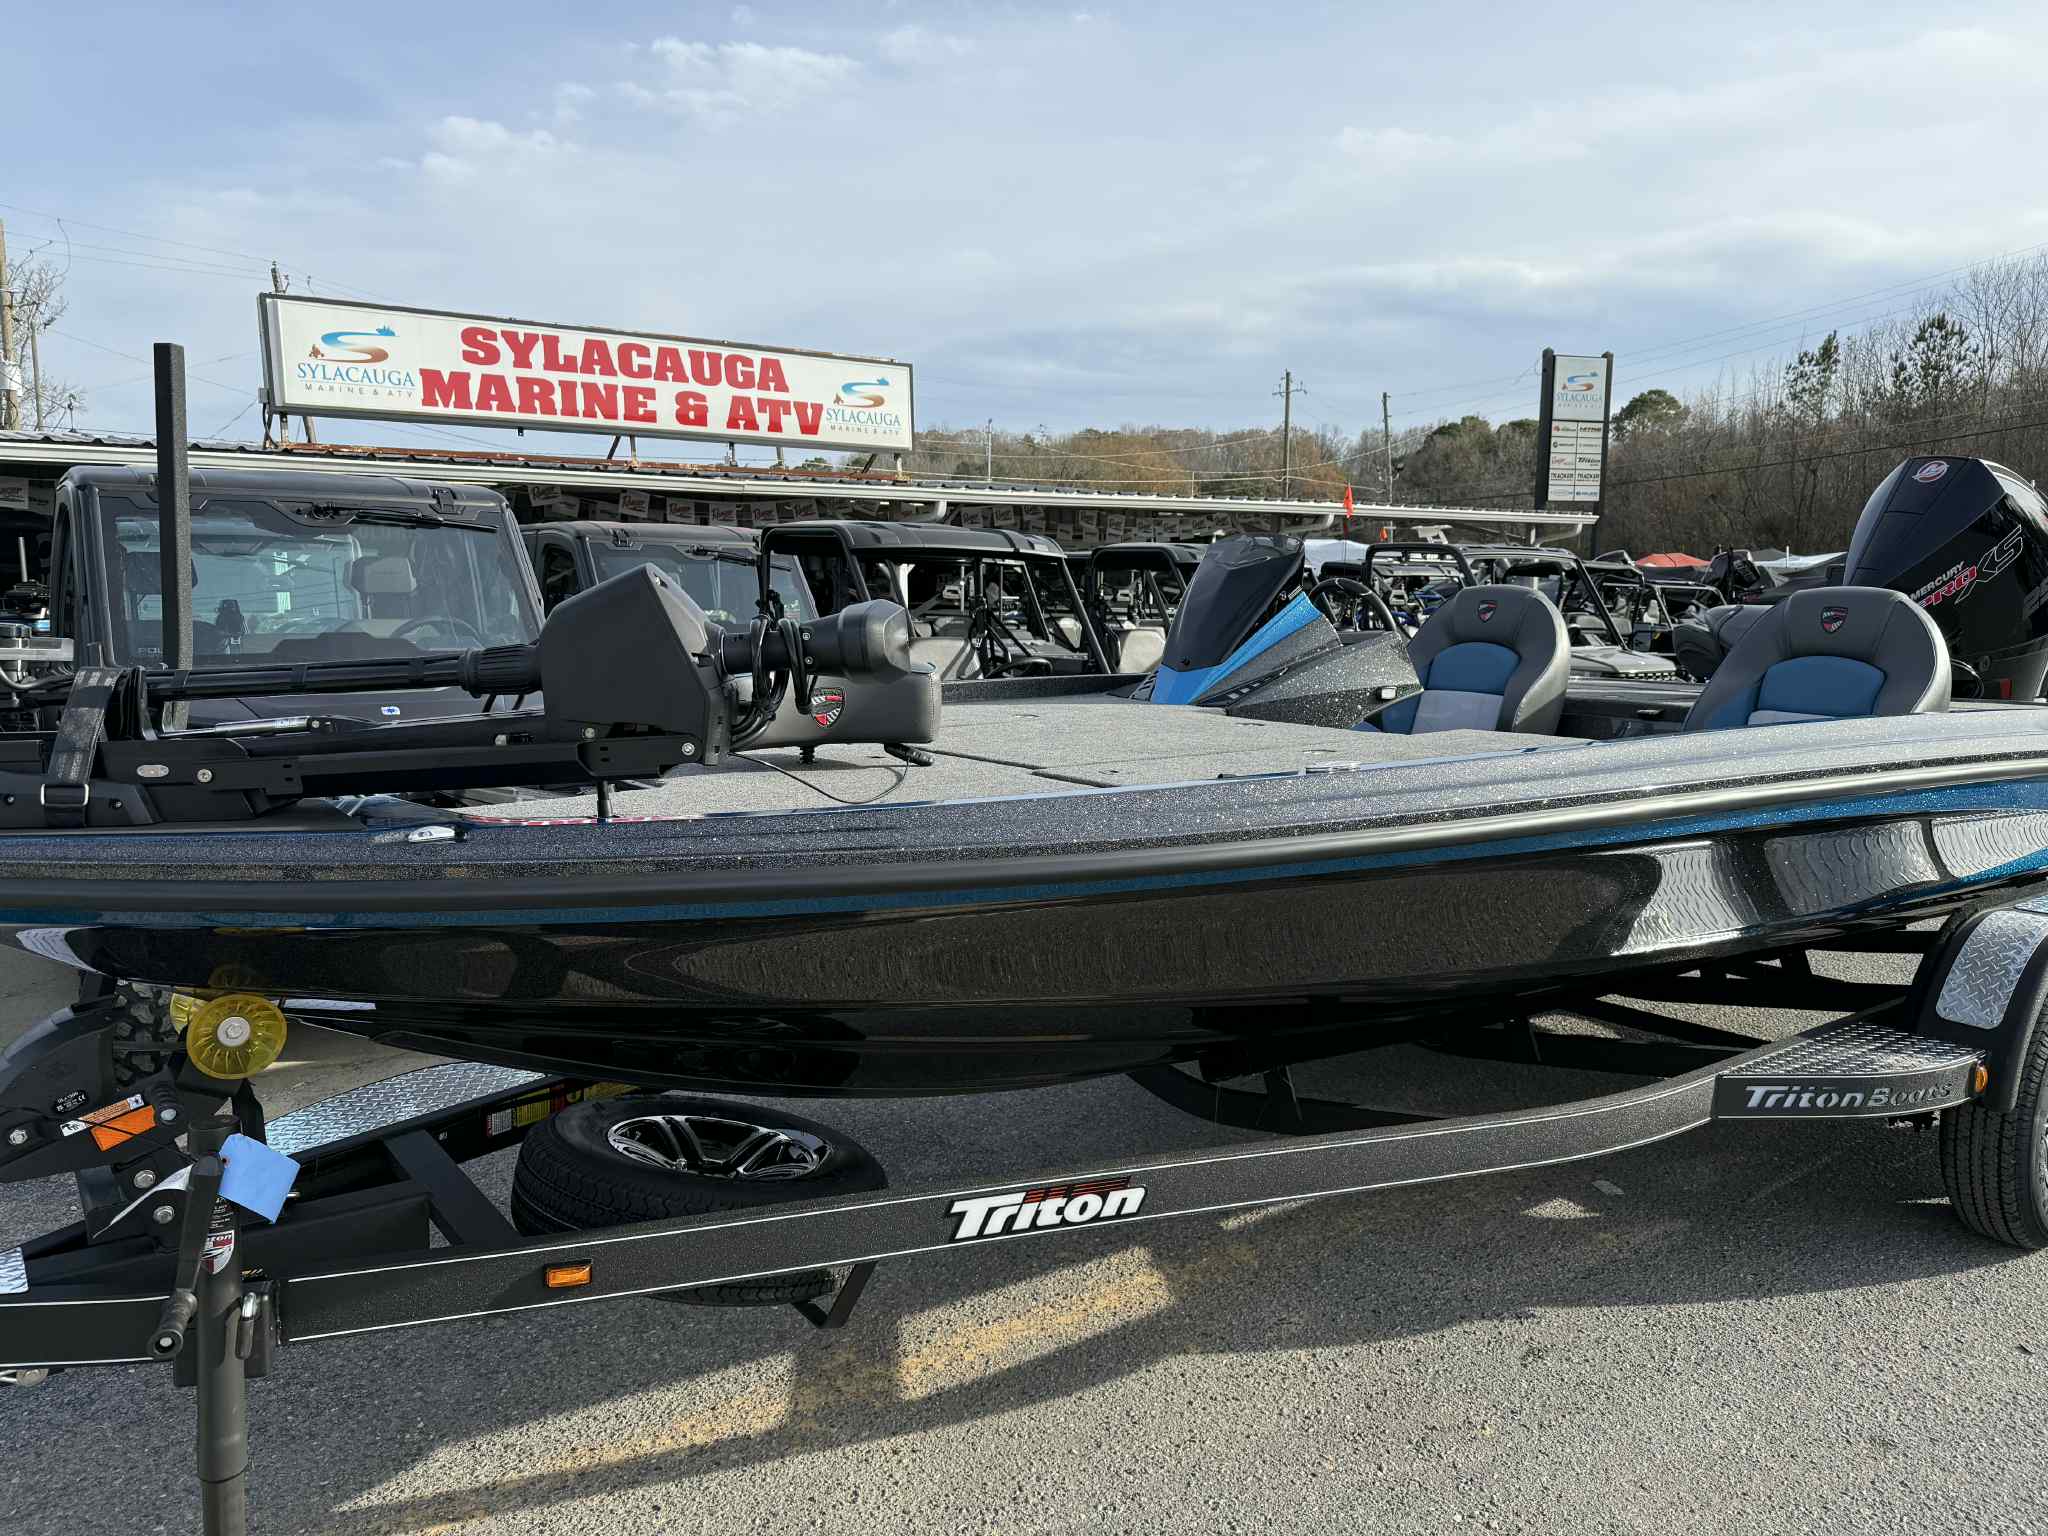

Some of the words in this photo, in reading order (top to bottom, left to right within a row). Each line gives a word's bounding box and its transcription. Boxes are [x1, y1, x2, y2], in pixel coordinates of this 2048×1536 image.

[298, 363, 415, 387] SYLACAUGA
[461, 327, 790, 393] SYLACAUGA
[305, 383, 363, 395] MARINE
[387, 390, 412, 398] ATV
[419, 368, 657, 426] MARINE
[674, 391, 709, 427] &
[726, 395, 824, 436] ATV
[826, 408, 900, 426] SYLACAUGA
[1910, 561, 1964, 600] MERCURY
[1919, 565, 1977, 608] PRO
[1954, 524, 2023, 605] XS
[1745, 1085, 1865, 1108] Triton
[1866, 1083, 1952, 1107] Boats
[950, 1187, 1146, 1240] Triton
